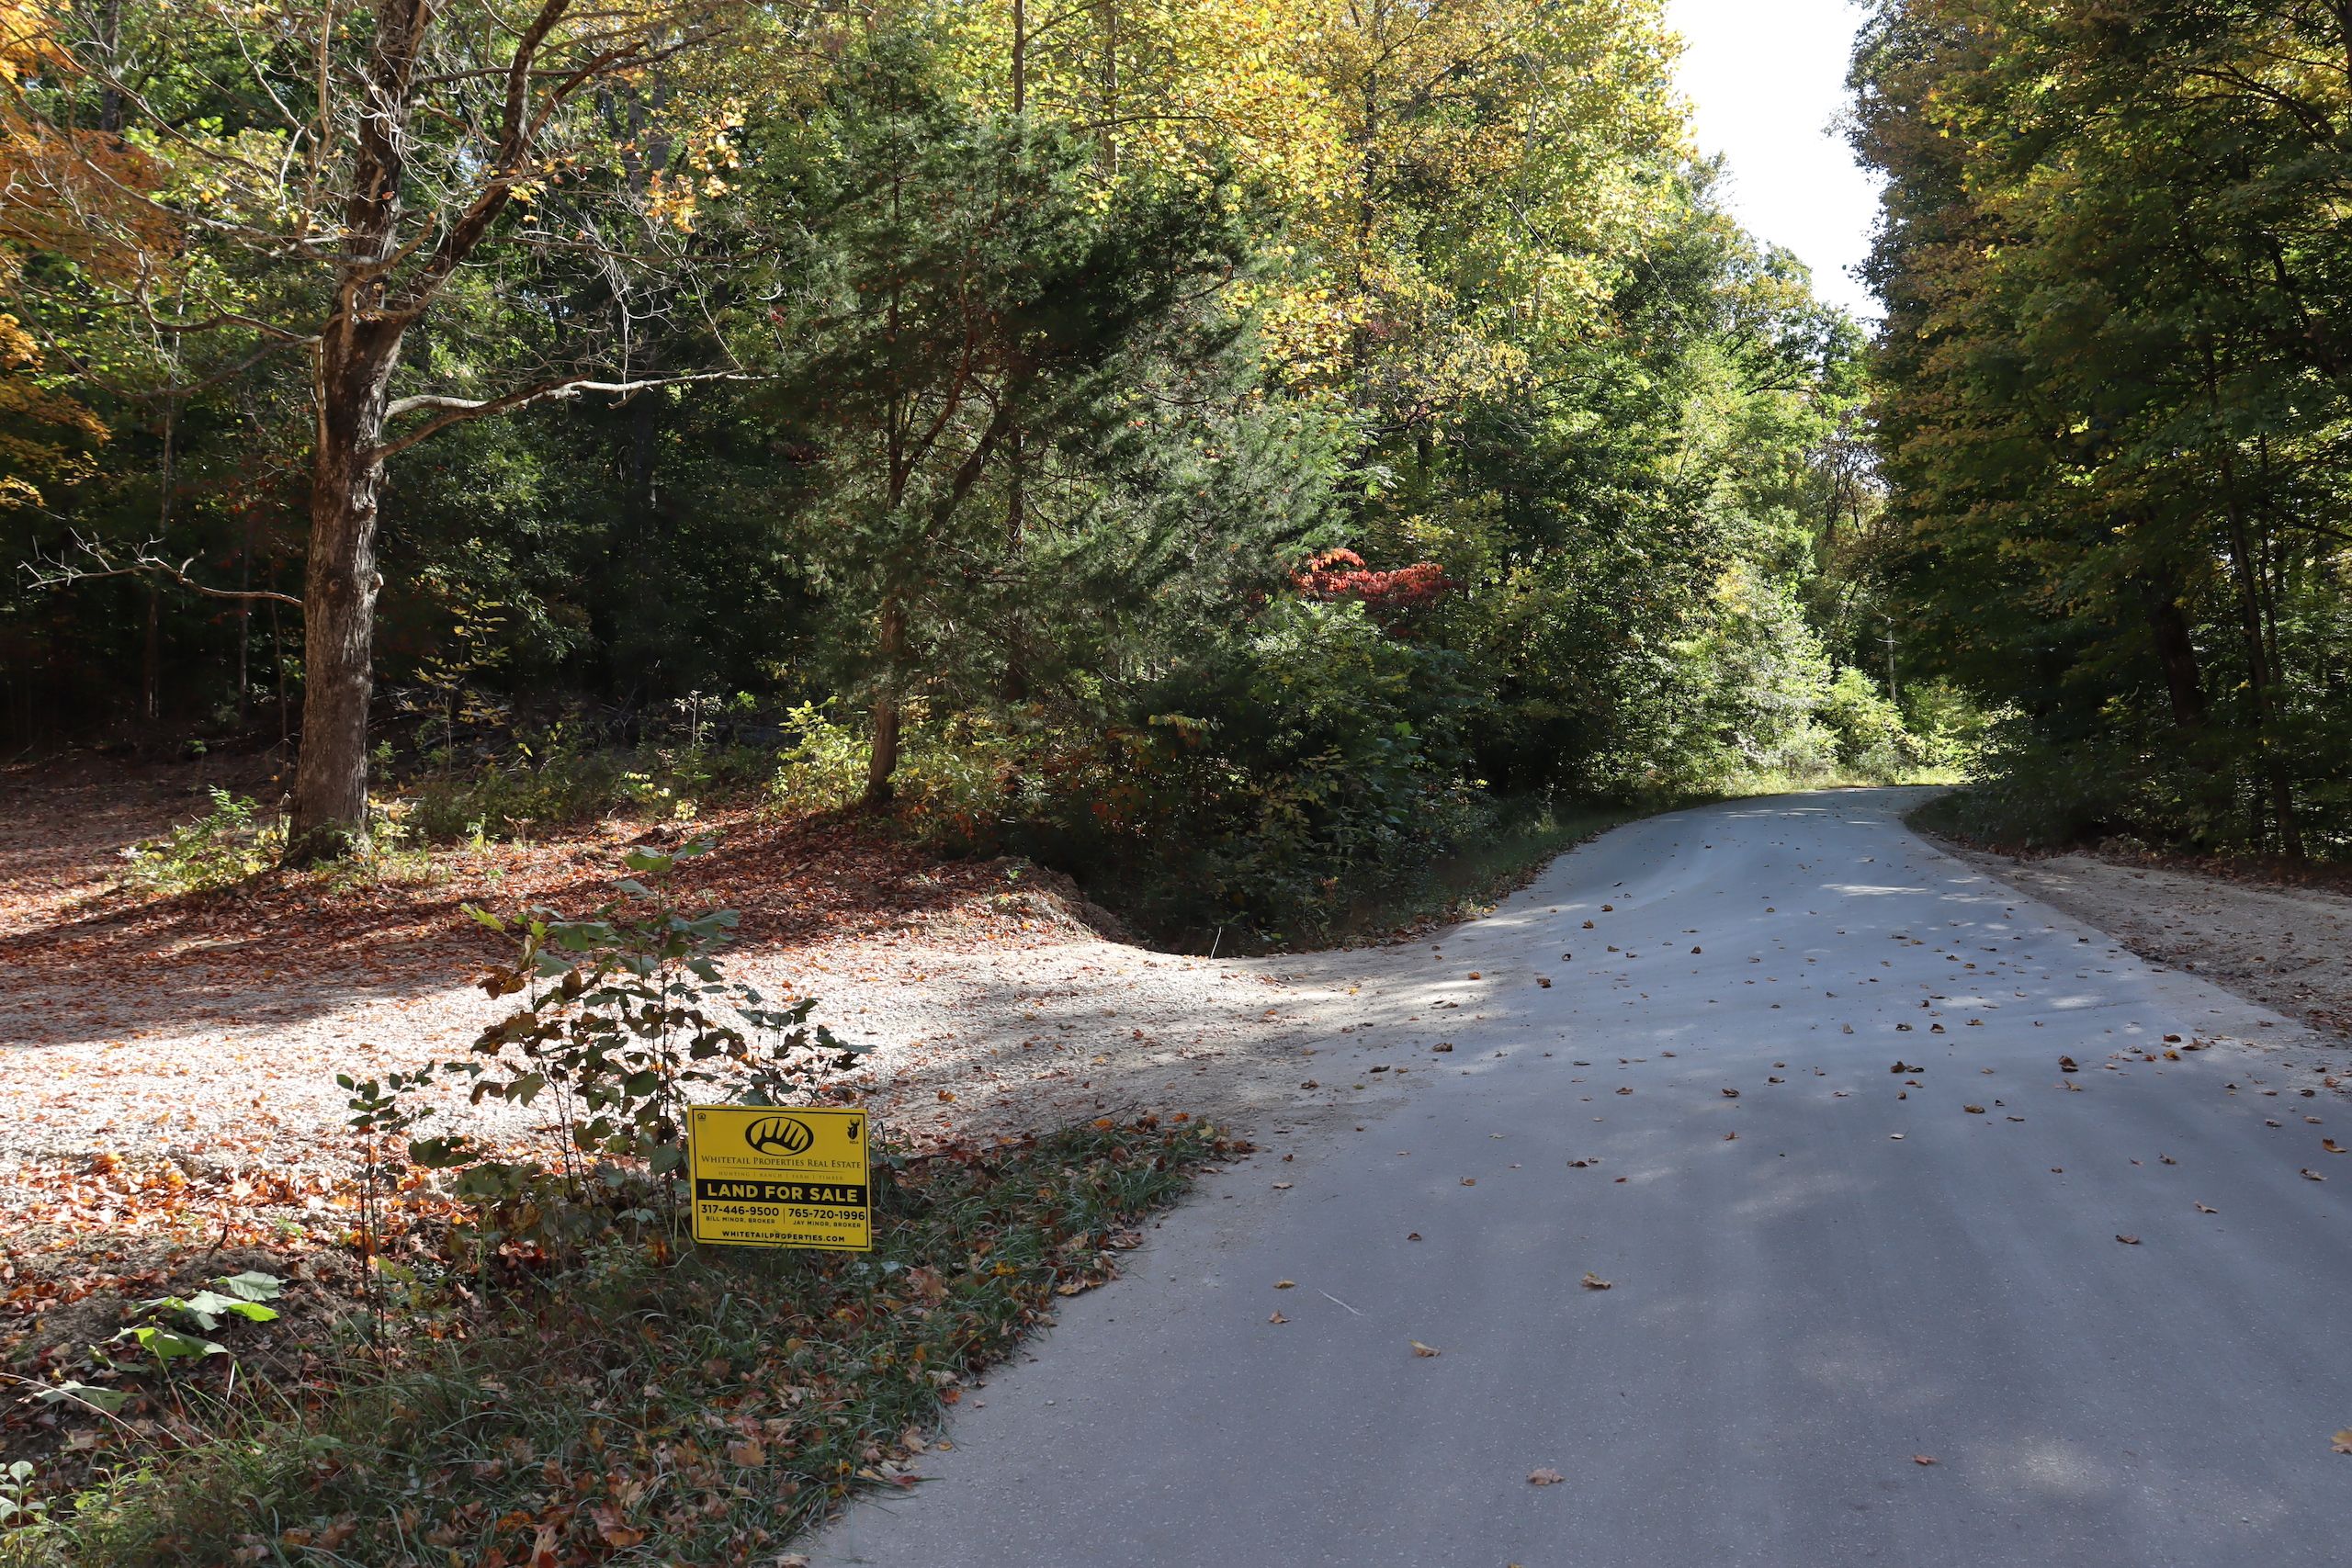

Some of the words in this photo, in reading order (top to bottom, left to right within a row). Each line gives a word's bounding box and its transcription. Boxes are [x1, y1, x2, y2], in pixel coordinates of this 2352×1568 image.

[707, 1183, 758, 1198] LAND
[764, 1186, 803, 1201] FOR
[809, 1188, 858, 1202] SALE
[701, 1204, 779, 1216] 317-446-9500
[788, 1208, 865, 1221] 765-720-1996
[722, 1230, 845, 1243] WHITETAILPROPERTIES.COM
